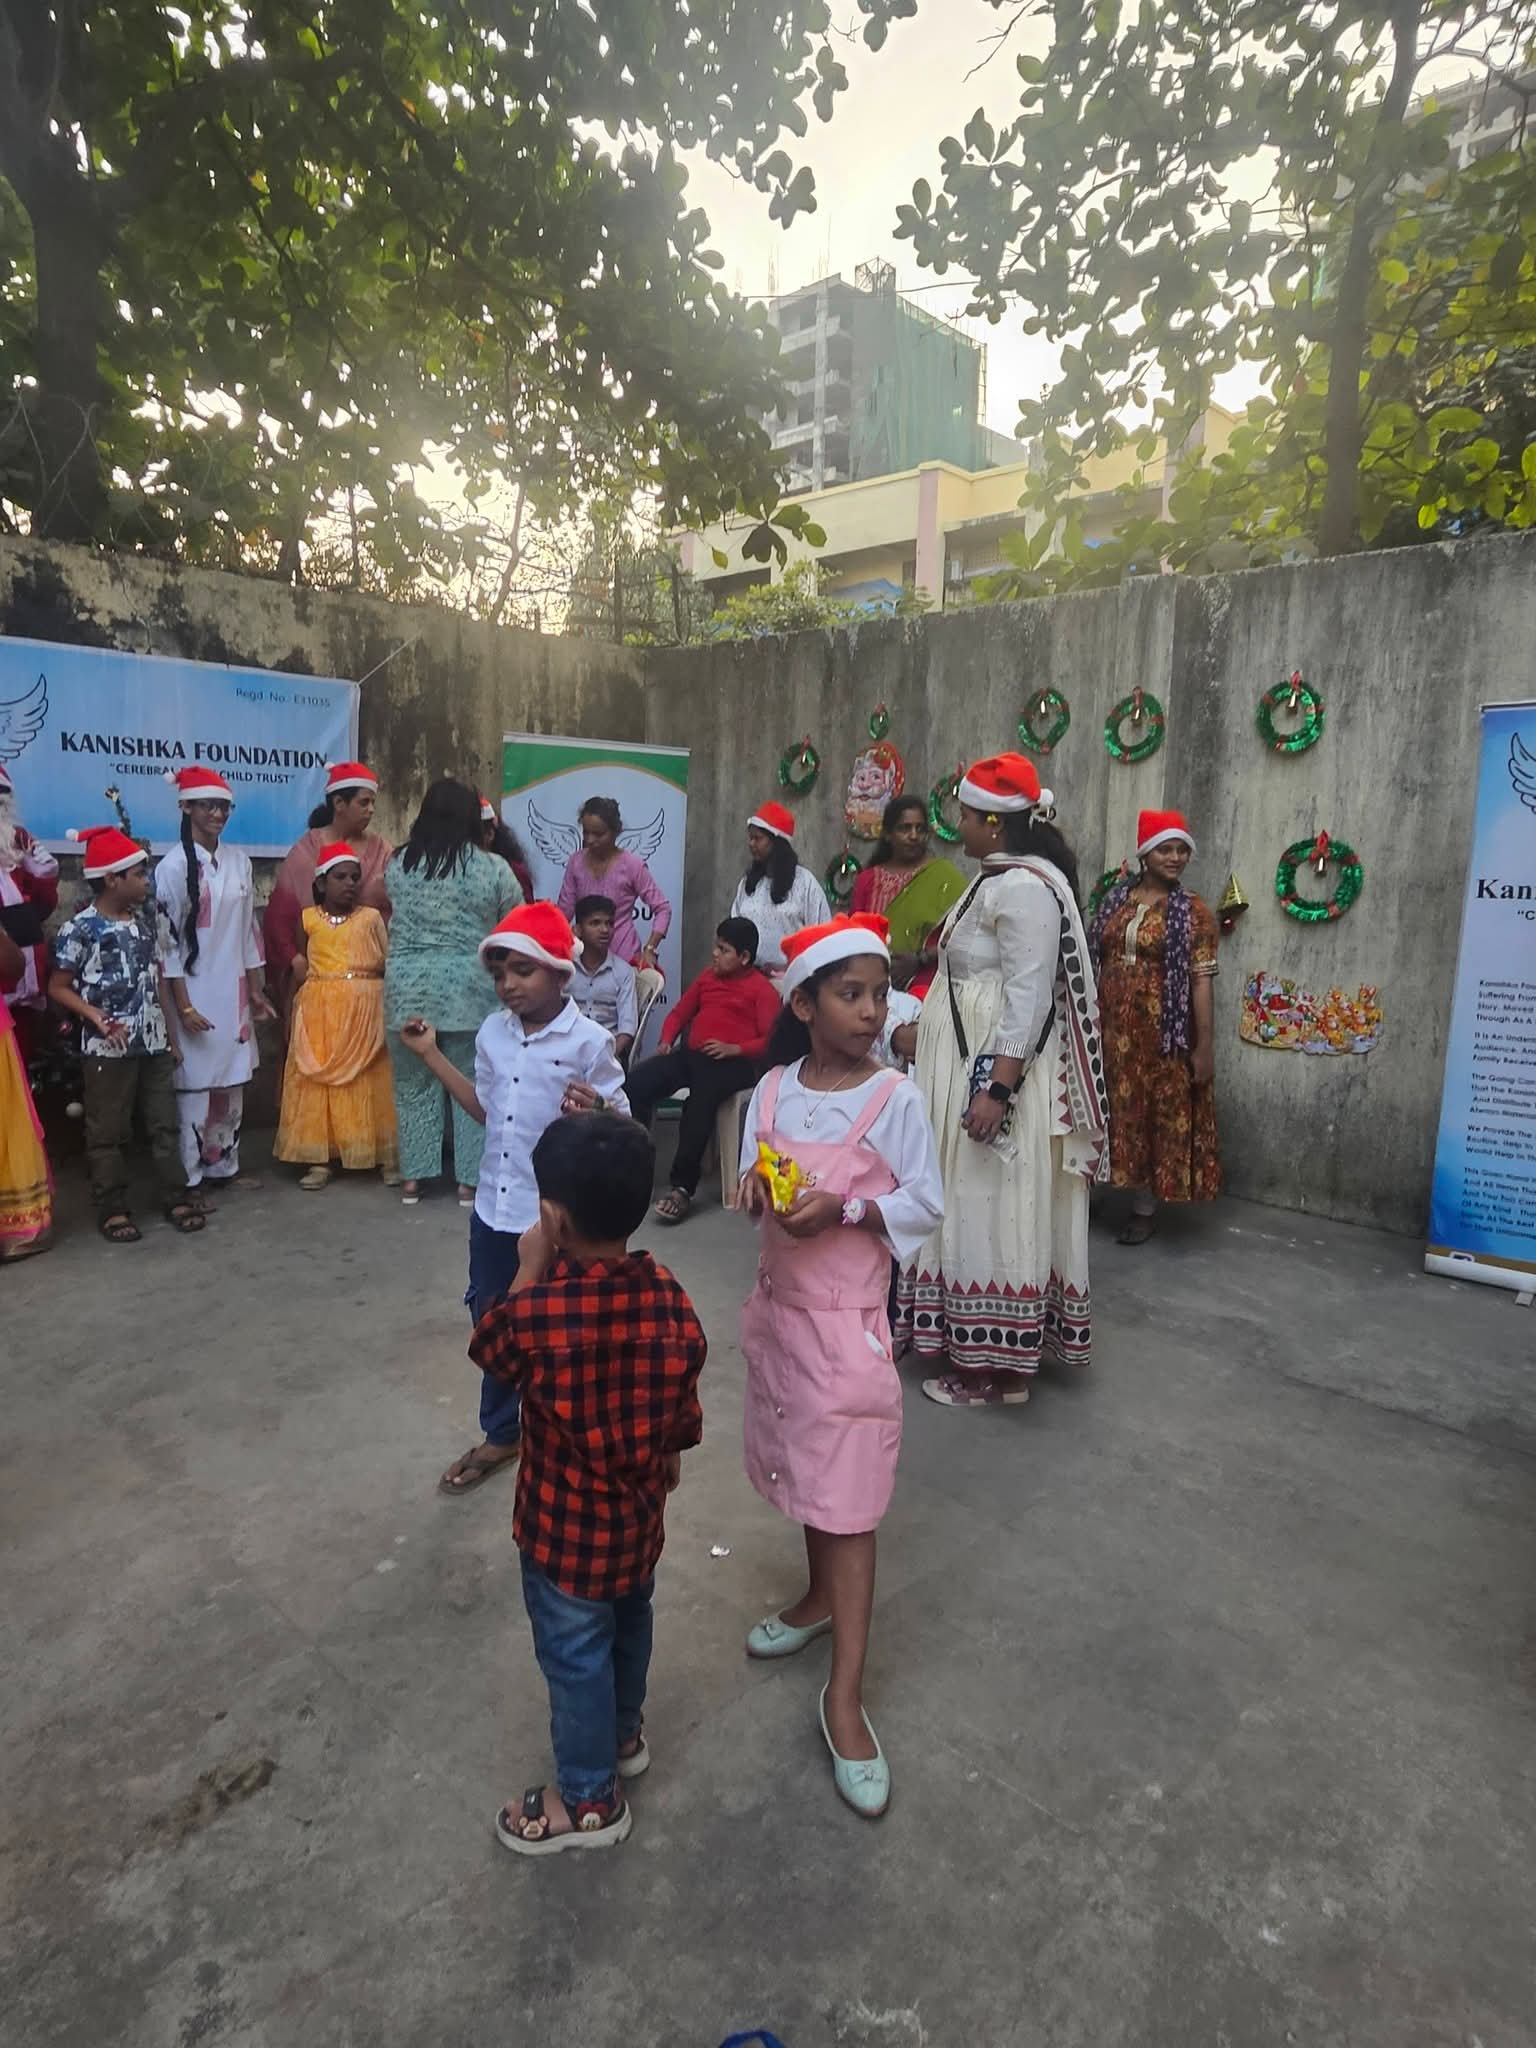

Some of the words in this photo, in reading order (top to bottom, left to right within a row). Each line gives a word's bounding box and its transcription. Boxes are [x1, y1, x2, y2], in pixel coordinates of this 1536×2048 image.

[60, 731, 186, 760] KANISHKA
[194, 741, 328, 769] FOUNDATION
[220, 770, 253, 782] CHILD
[1475, 878, 1536, 900] Kan
